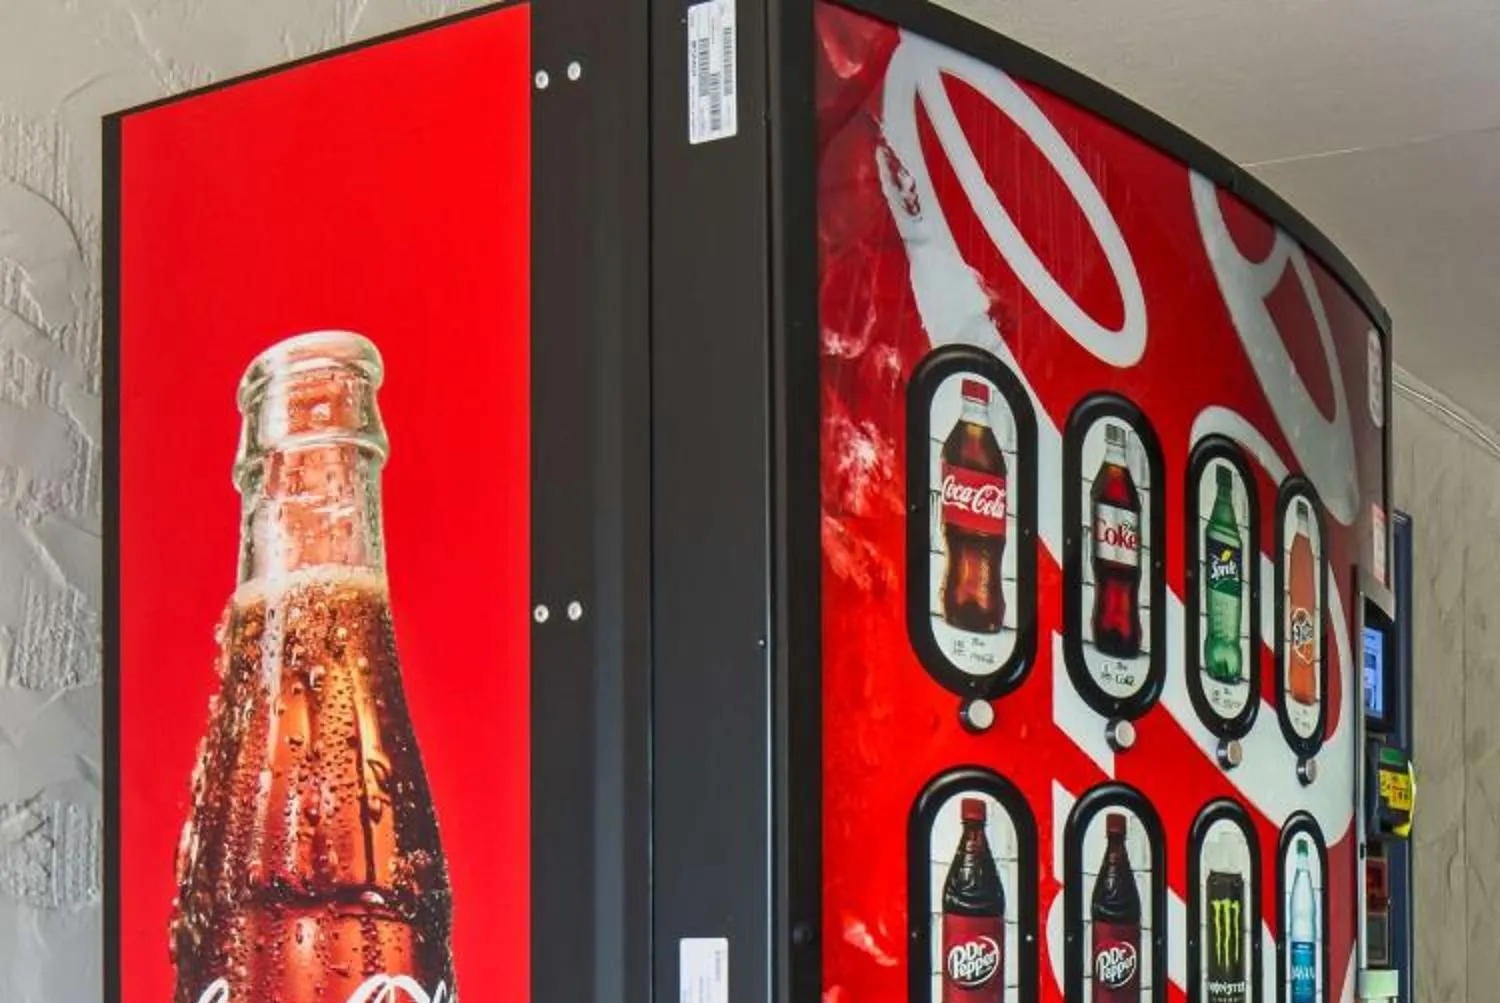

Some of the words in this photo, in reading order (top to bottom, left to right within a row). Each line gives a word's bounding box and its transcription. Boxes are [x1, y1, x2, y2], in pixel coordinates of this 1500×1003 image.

[941, 475, 1007, 519] Coca-Cola
[1093, 518, 1139, 550] Coke
[952, 945, 997, 980] Pepper
[967, 942, 985, 959] Dr
[1099, 949, 1136, 982] Pepper
[1109, 947, 1126, 963] Dr
